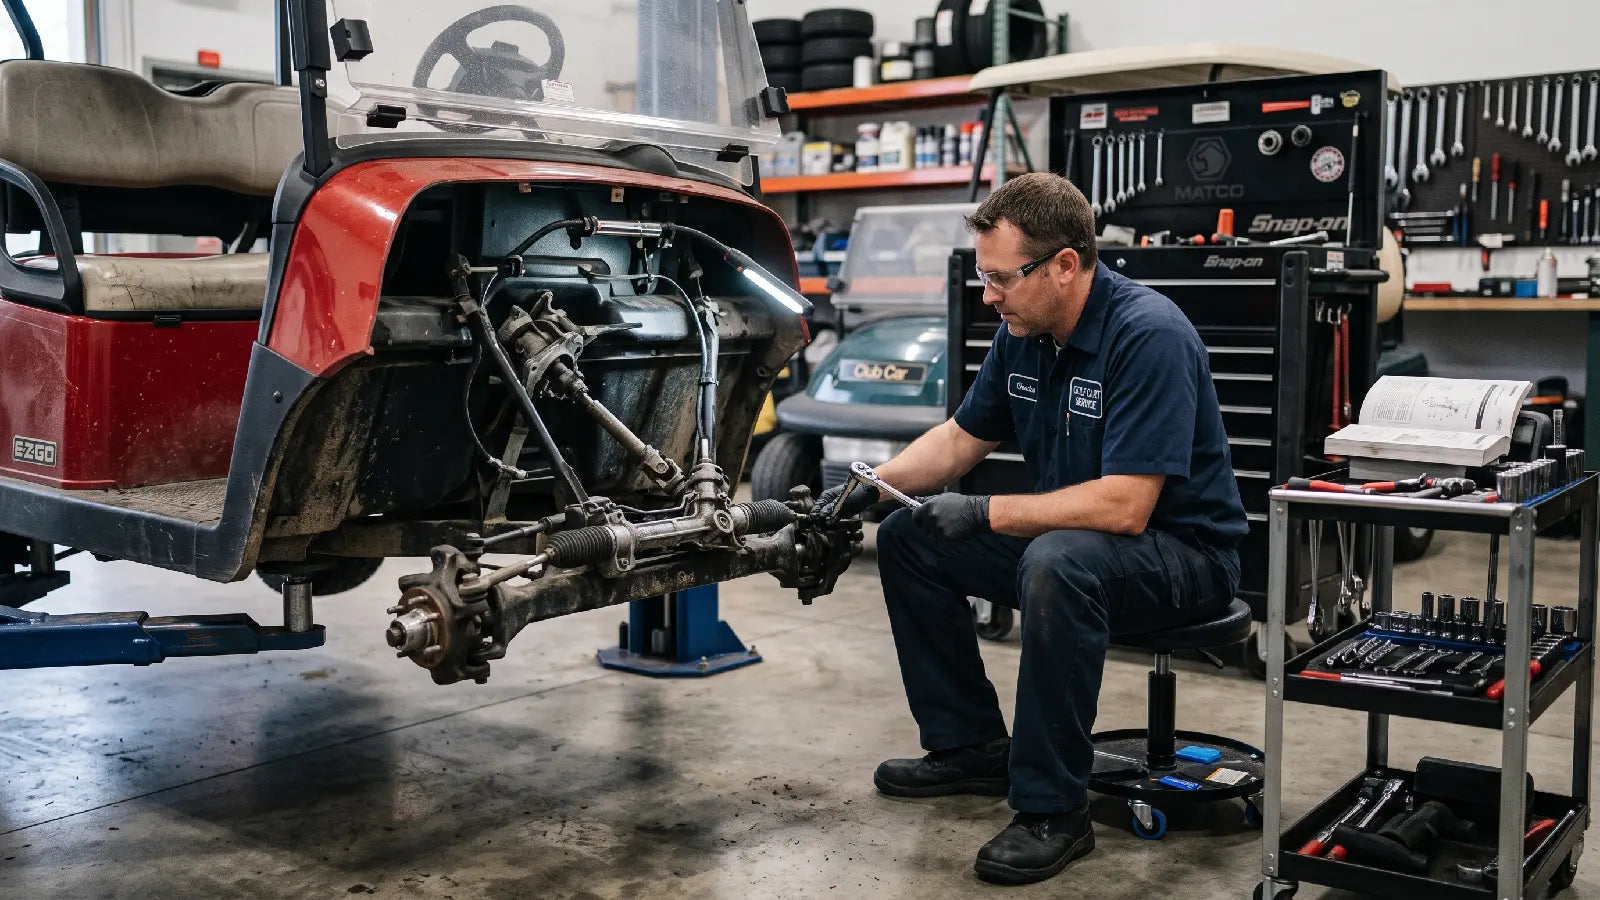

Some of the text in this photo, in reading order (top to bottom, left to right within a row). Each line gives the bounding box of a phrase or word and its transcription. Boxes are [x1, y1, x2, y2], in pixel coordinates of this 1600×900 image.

[1174, 184, 1244, 200] MATCO
[1248, 213, 1348, 235] Snap-on
[1203, 255, 1264, 269] Snap-on
